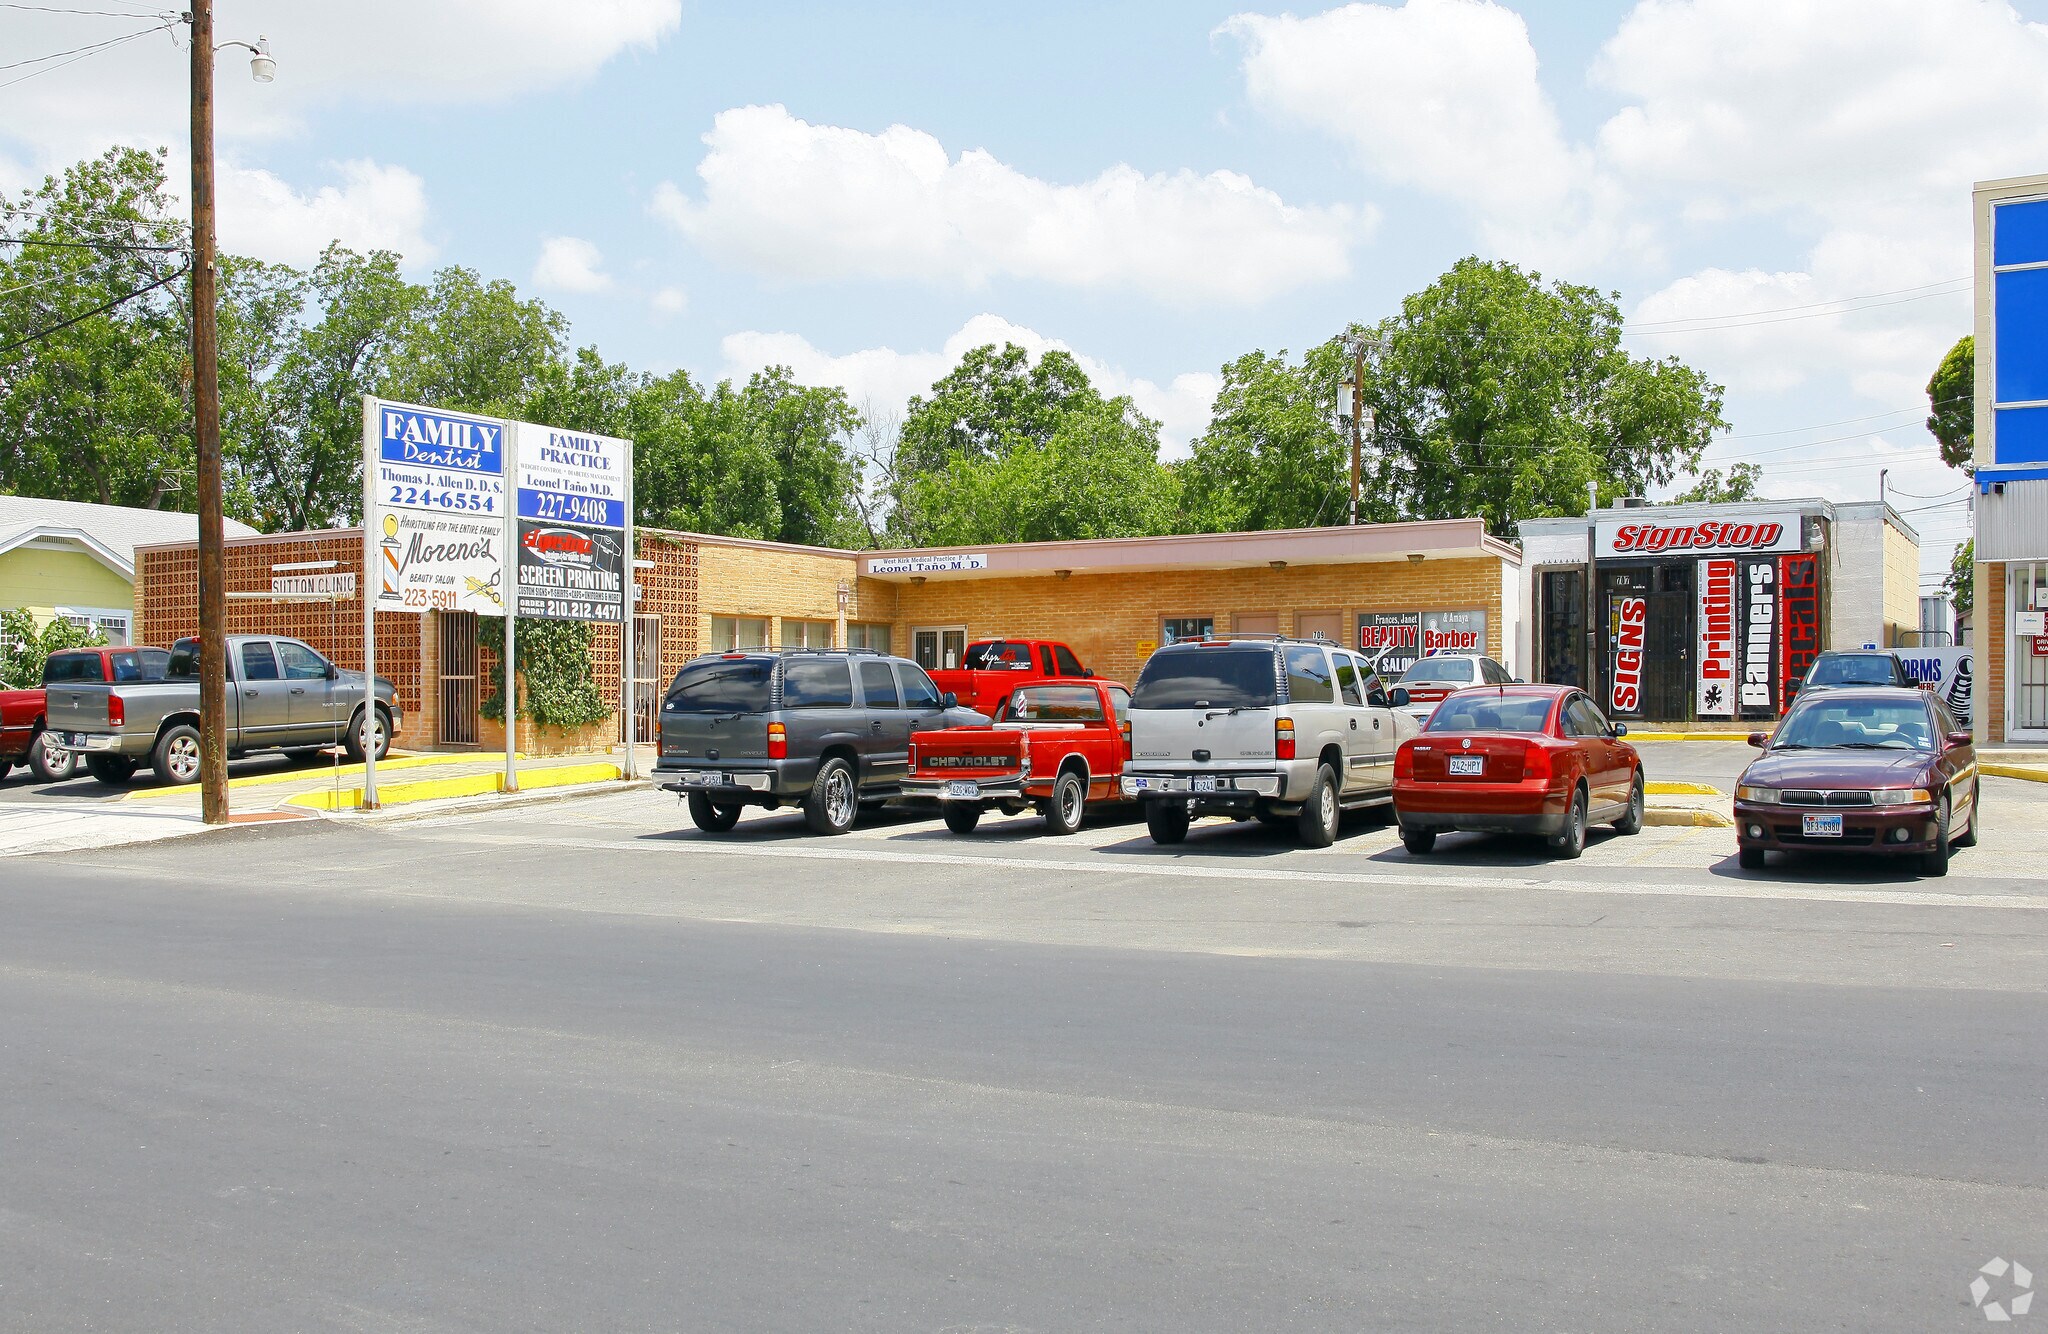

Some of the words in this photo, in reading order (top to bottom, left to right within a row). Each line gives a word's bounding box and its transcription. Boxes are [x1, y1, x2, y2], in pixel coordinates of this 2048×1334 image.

[385, 412, 498, 453] FAMILY
[550, 433, 602, 454] FAMILY
[404, 441, 482, 469] Dentist
[540, 448, 611, 470] PRACTICE
[381, 467, 422, 485] Thomas
[425, 474, 434, 486] J.
[437, 476, 463, 490] Allen
[527, 474, 560, 489] Leonel
[562, 479, 587, 492] Taño
[590, 483, 614, 496] M.D.
[390, 486, 494, 512] 224-6554
[537, 492, 607, 523] 227-9408
[436, 522, 447, 531] FOR
[448, 523, 458, 532] THE
[459, 524, 479, 534] ENTIRE
[479, 526, 501, 536] FAMILY
[1613, 521, 1783, 552] SignStop
[400, 532, 497, 576] Moreno's
[520, 565, 564, 587] SCREEN
[567, 569, 619, 591] PRINTING
[873, 564, 912, 573] Leonel
[916, 562, 946, 571] Taño
[273, 578, 314, 593] SUTTON
[318, 576, 353, 592] CLINIC
[410, 574, 433, 583] BEAUTY
[435, 575, 456, 585] SALON
[404, 588, 457, 608] 223-5911
[518, 586, 534, 595] CUSTOM
[536, 588, 547, 596] SIGNS
[520, 599, 545, 607] ORDER
[548, 600, 620, 619] 210.212.4471
[1375, 614, 1399, 624] Frances,
[1401, 614, 1417, 624] Janet
[1449, 612, 1469, 624] Amaya
[1702, 561, 1734, 679] Printing
[1361, 625, 1418, 648] BEAUTY
[1425, 629, 1478, 649] Barber
[1742, 564, 1773, 706] Banners
[1613, 599, 1646, 710] SIGNS
[930, 756, 1007, 766] CHEVROLET
